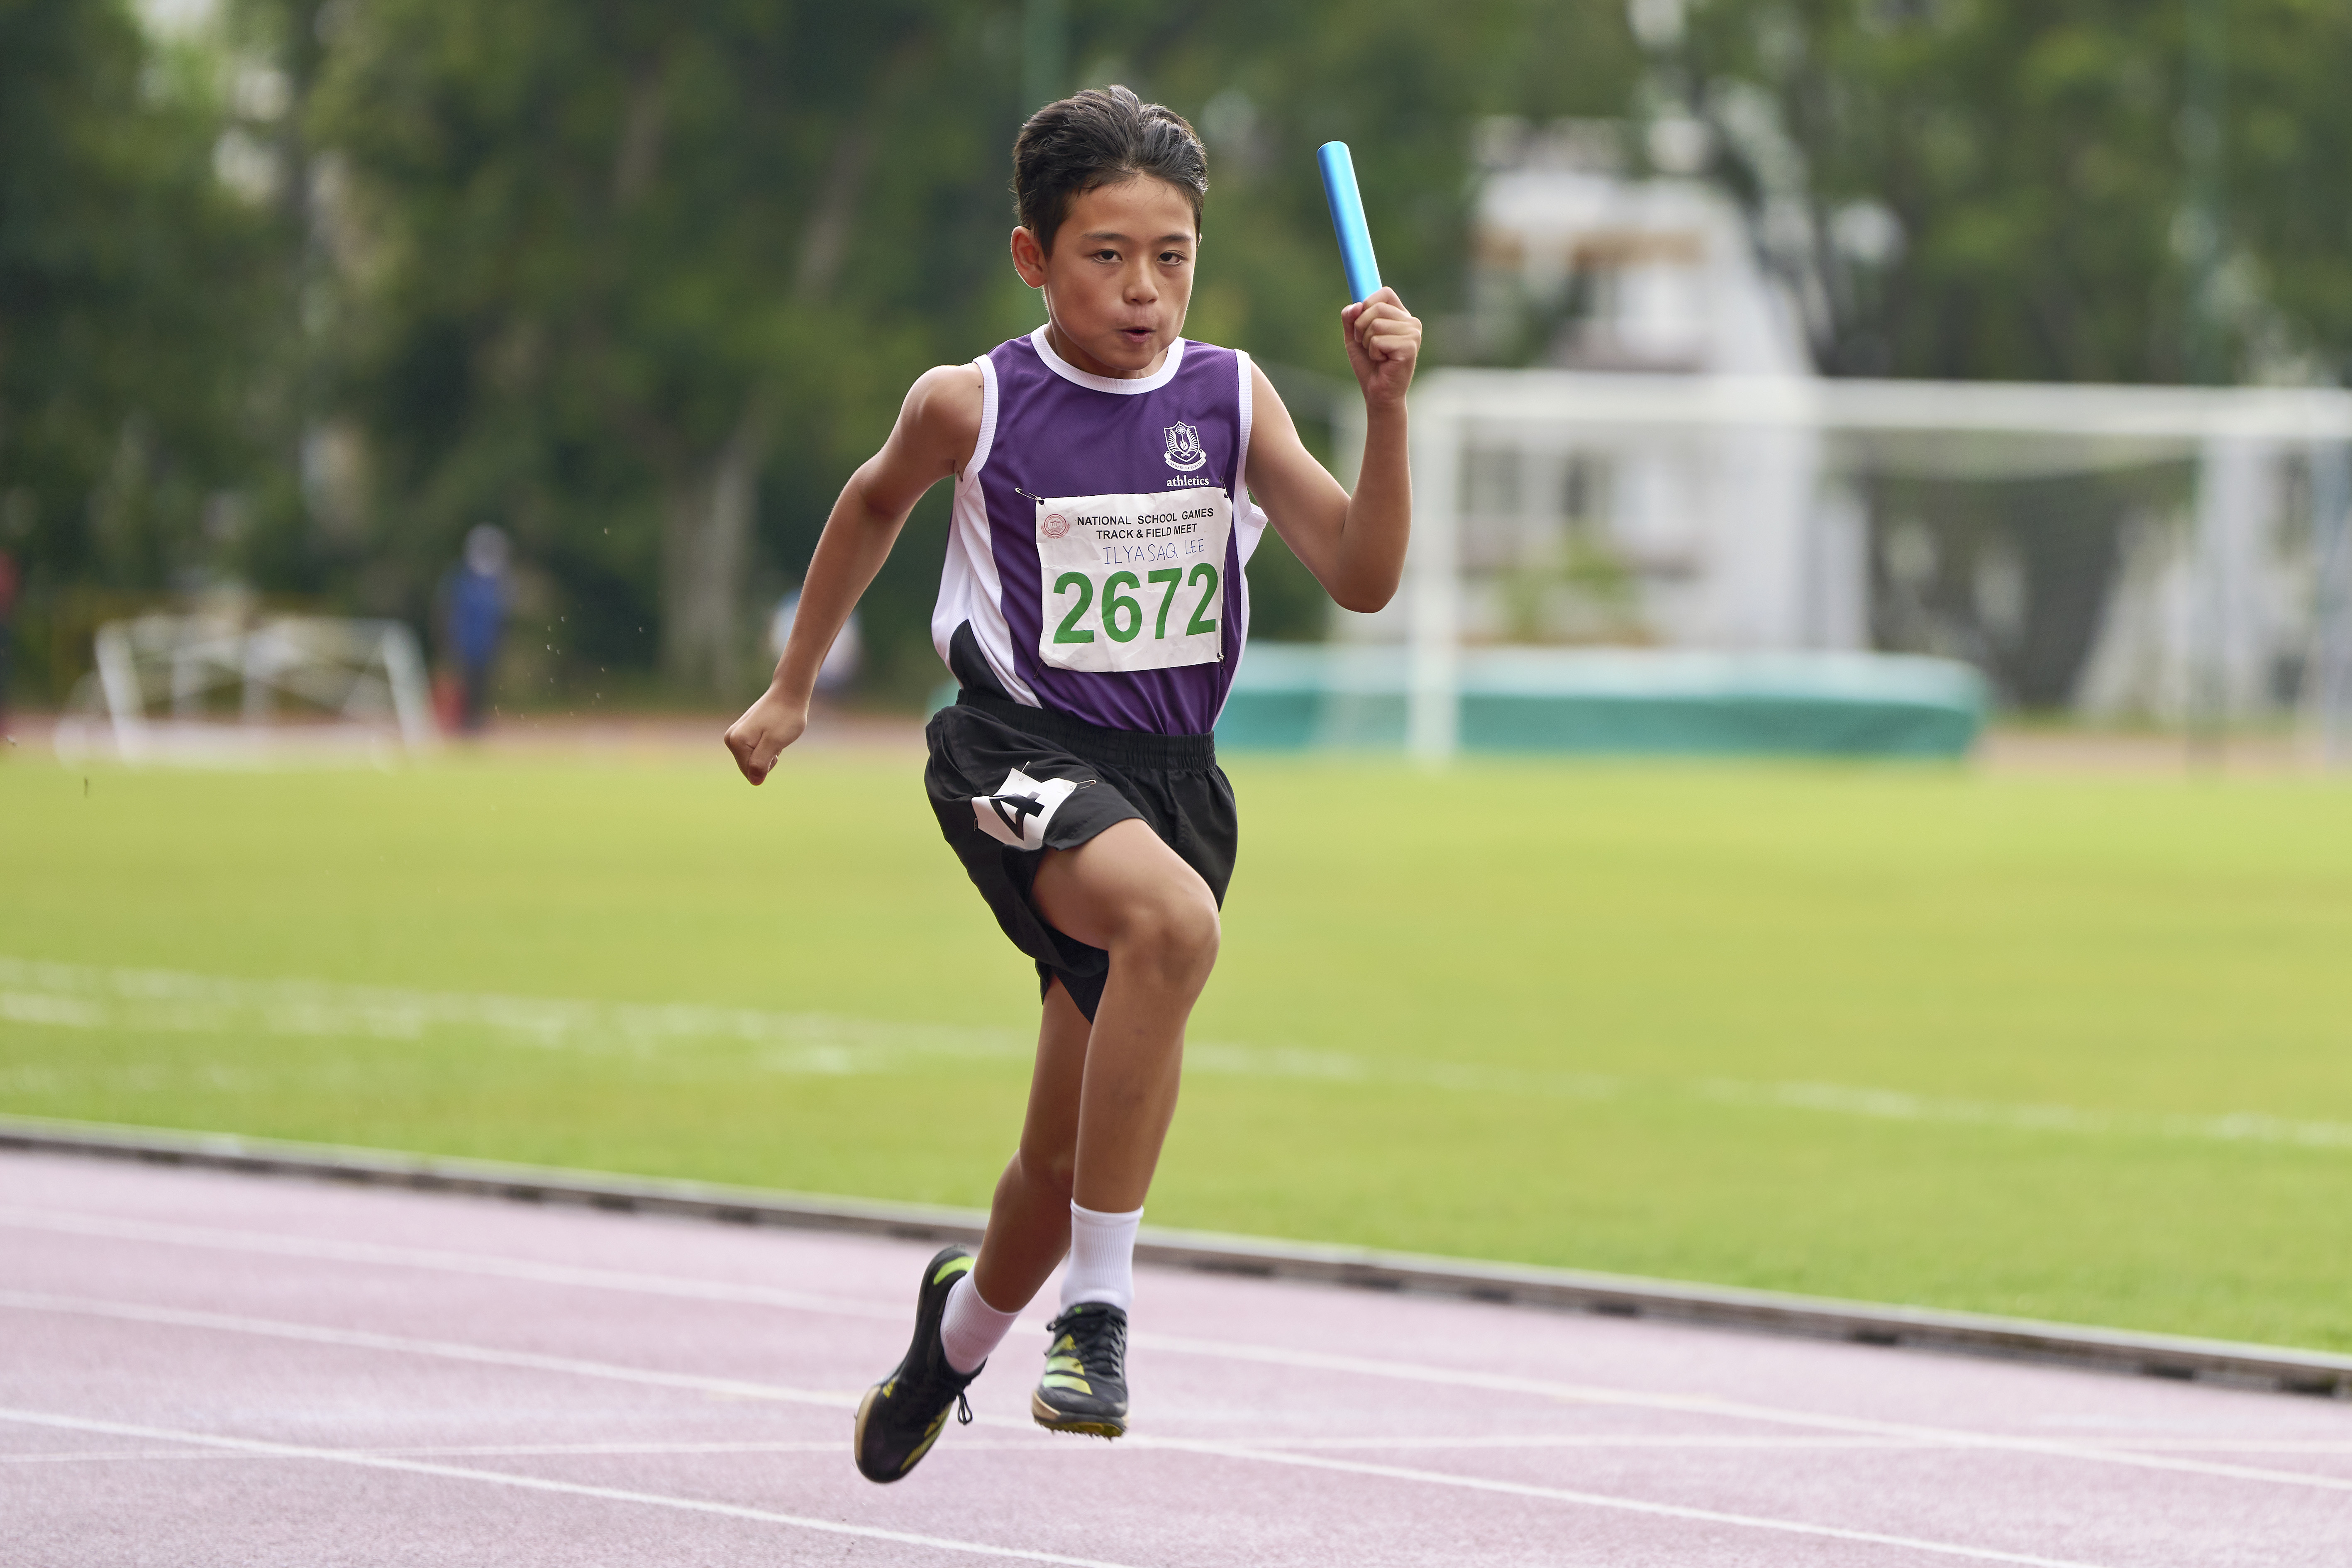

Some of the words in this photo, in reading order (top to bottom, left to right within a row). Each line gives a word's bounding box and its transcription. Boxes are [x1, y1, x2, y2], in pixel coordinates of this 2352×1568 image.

[1166, 474, 1209, 487] athletics
[1077, 516, 1132, 525] NATIONAL
[1137, 513, 1177, 524] SCHOOL
[1182, 508, 1214, 520] GAMES
[1096, 529, 1134, 539] TRACK
[1136, 529, 1143, 538] &
[1146, 527, 1171, 538] FIELD
[1174, 523, 1197, 535] MEET
[1103, 543, 1178, 565] ILYASAQ
[1185, 539, 1204, 554] LEE
[1053, 562, 1219, 644] 2672
[989, 791, 1045, 841] 4
